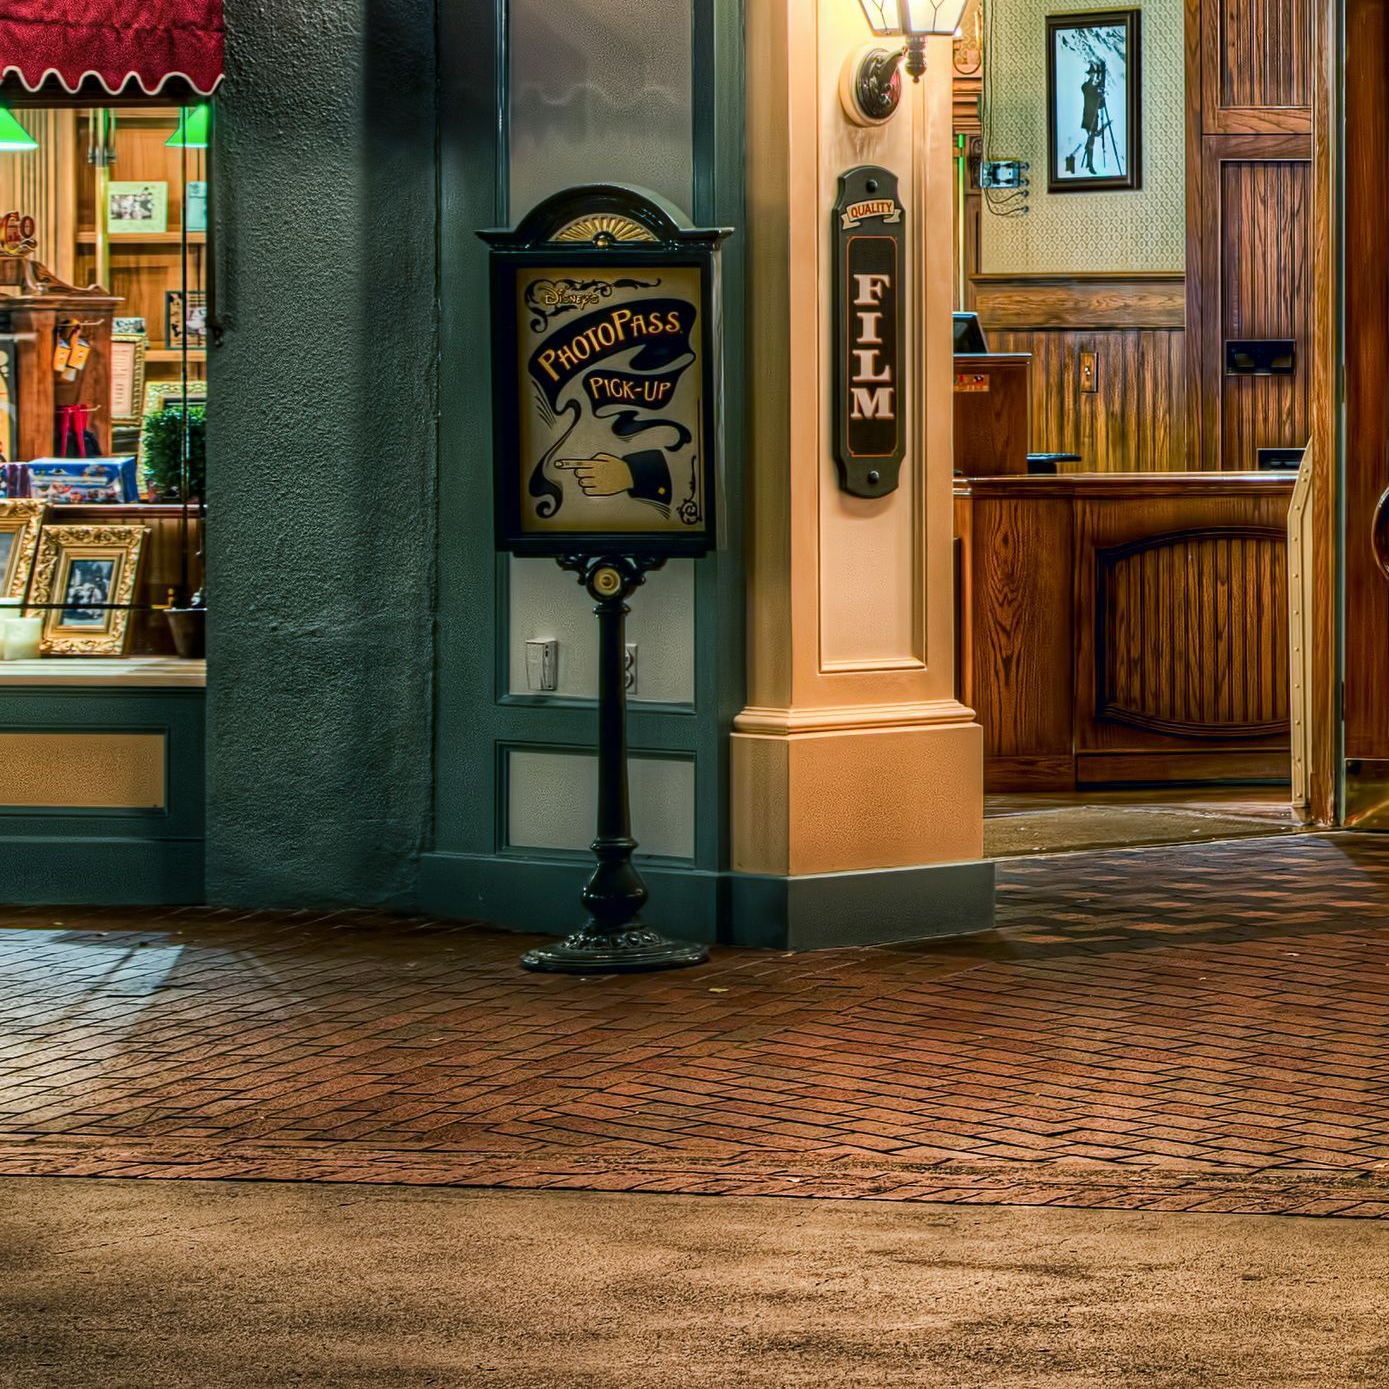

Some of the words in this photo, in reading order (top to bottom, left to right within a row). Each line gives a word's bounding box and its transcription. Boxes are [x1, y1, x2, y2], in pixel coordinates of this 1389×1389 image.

[850, 201, 893, 218] QUALITY
[850, 274, 894, 420] FILM
[589, 377, 671, 402] PICK-UP
